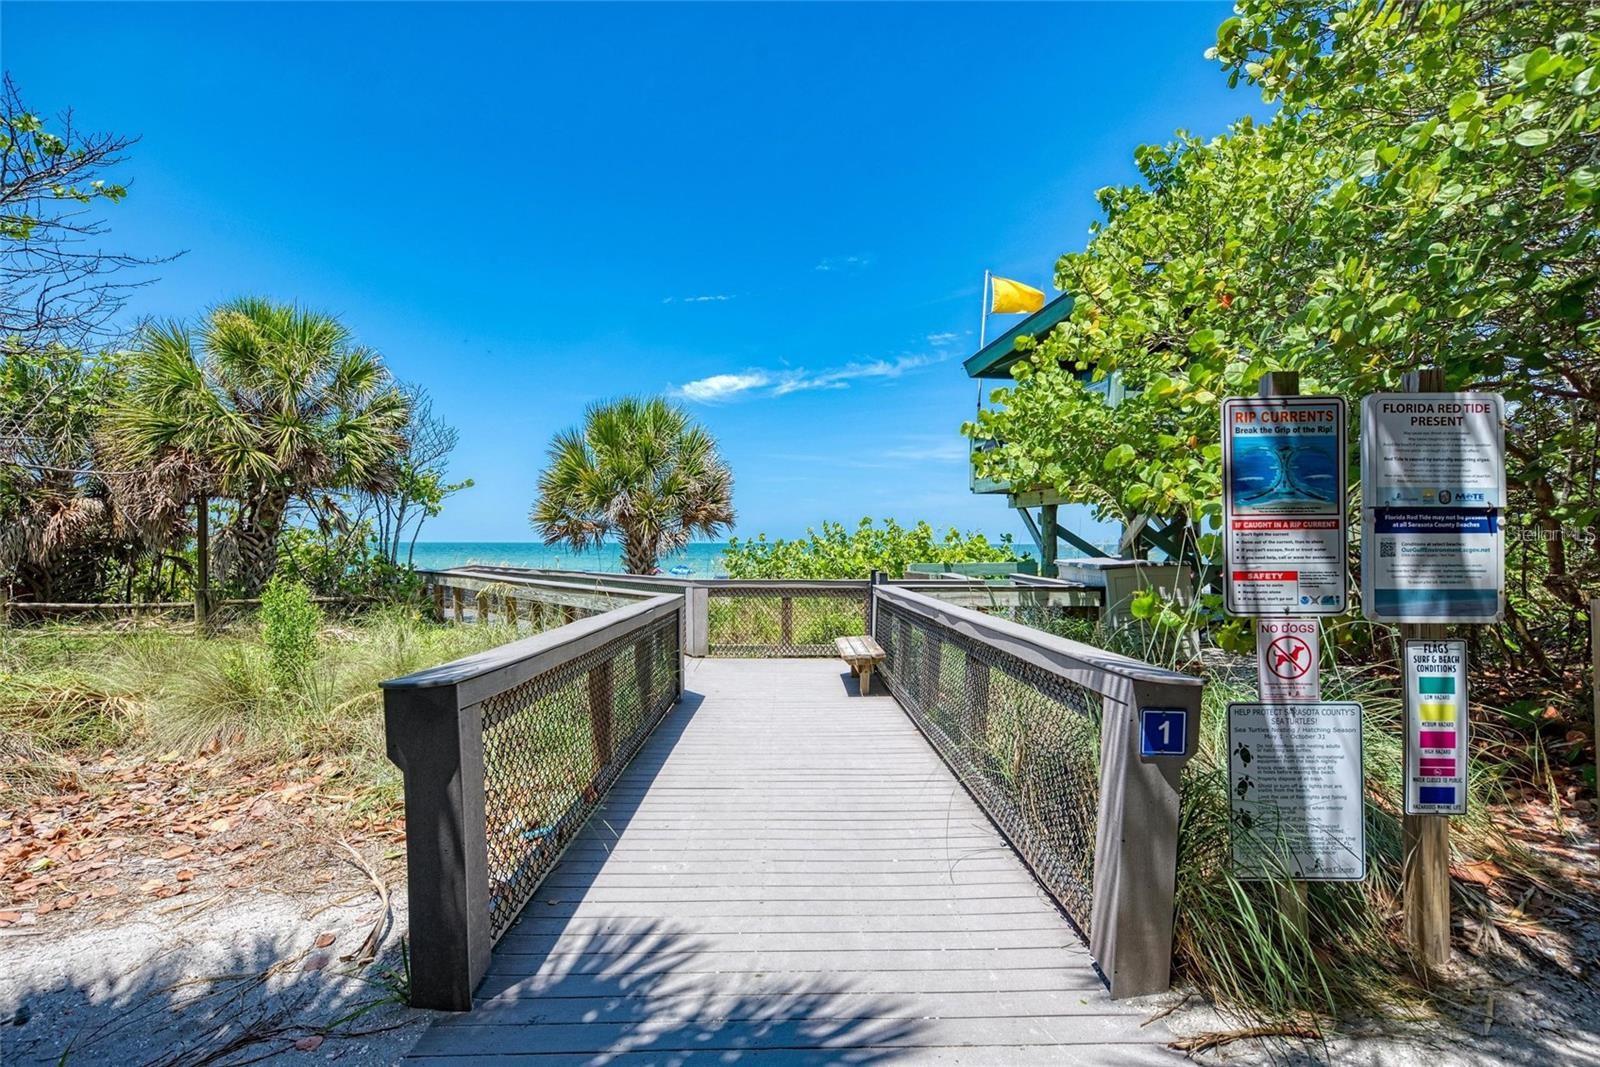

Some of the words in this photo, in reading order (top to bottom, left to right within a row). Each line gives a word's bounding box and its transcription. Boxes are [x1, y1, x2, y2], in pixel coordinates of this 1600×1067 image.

[1383, 404, 1434, 413] FLORIDA
[1438, 404, 1461, 413] RED
[1464, 404, 1490, 413] TIDE
[1235, 410, 1256, 423] RIP
[1261, 410, 1334, 423] CURRENTS
[1411, 417, 1463, 426] PRESENT
[1235, 426, 1257, 434] Break
[1260, 426, 1272, 434] the
[1275, 426, 1290, 434] Grip
[1293, 426, 1301, 434] of
[1303, 426, 1315, 434] the
[1318, 426, 1333, 434] Rip!
[1261, 624, 1278, 633] NO
[1282, 624, 1315, 633] DOGS
[1424, 644, 1449, 653] FLAGS
[1413, 656, 1429, 664] SURF
[1432, 656, 1437, 664] &
[1438, 656, 1460, 664] BEACH
[1158, 721, 1170, 744] 1
